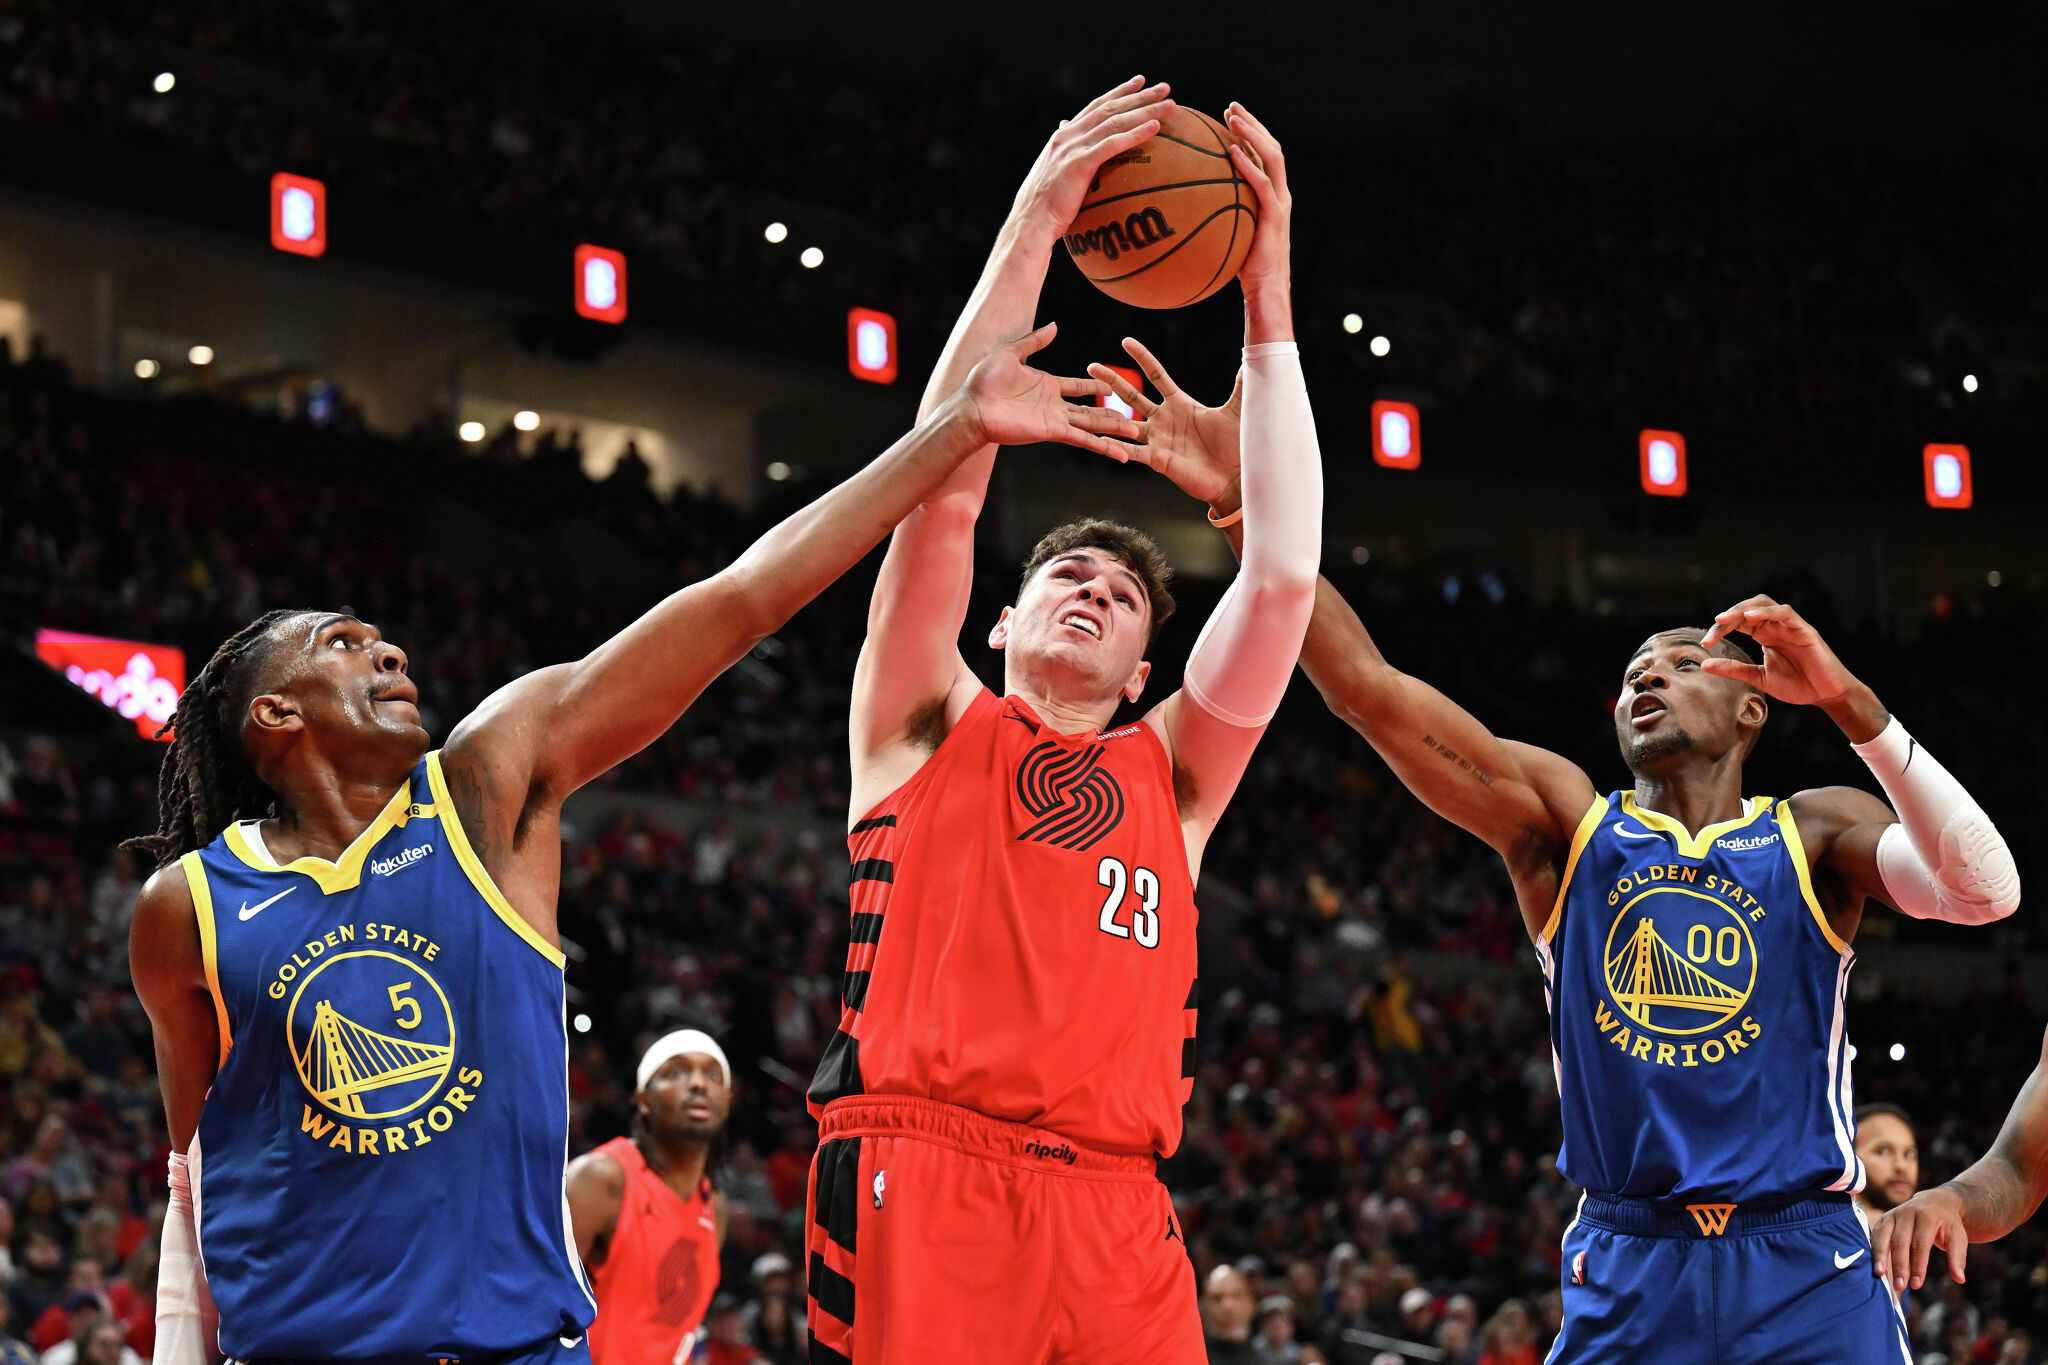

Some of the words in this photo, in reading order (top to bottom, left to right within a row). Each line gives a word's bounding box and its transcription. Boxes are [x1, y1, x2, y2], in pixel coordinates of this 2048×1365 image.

[1063, 206, 1176, 261] Wilson
[1097, 725, 1141, 741] GHTSIDE
[371, 843, 433, 875] Rakuten
[1716, 833, 1779, 849] Rakuten
[1097, 856, 1160, 949] 23
[1608, 864, 1697, 906] GOLDEN
[1704, 874, 1766, 922] STATE
[268, 923, 355, 999] GOLDEN
[365, 922, 441, 962] STATE
[1687, 924, 1741, 967] 00
[387, 981, 422, 1029] 5
[1594, 999, 1762, 1067] WARRIORS
[300, 1066, 483, 1155] WARRIORS
[1025, 1140, 1078, 1165] ripcity
